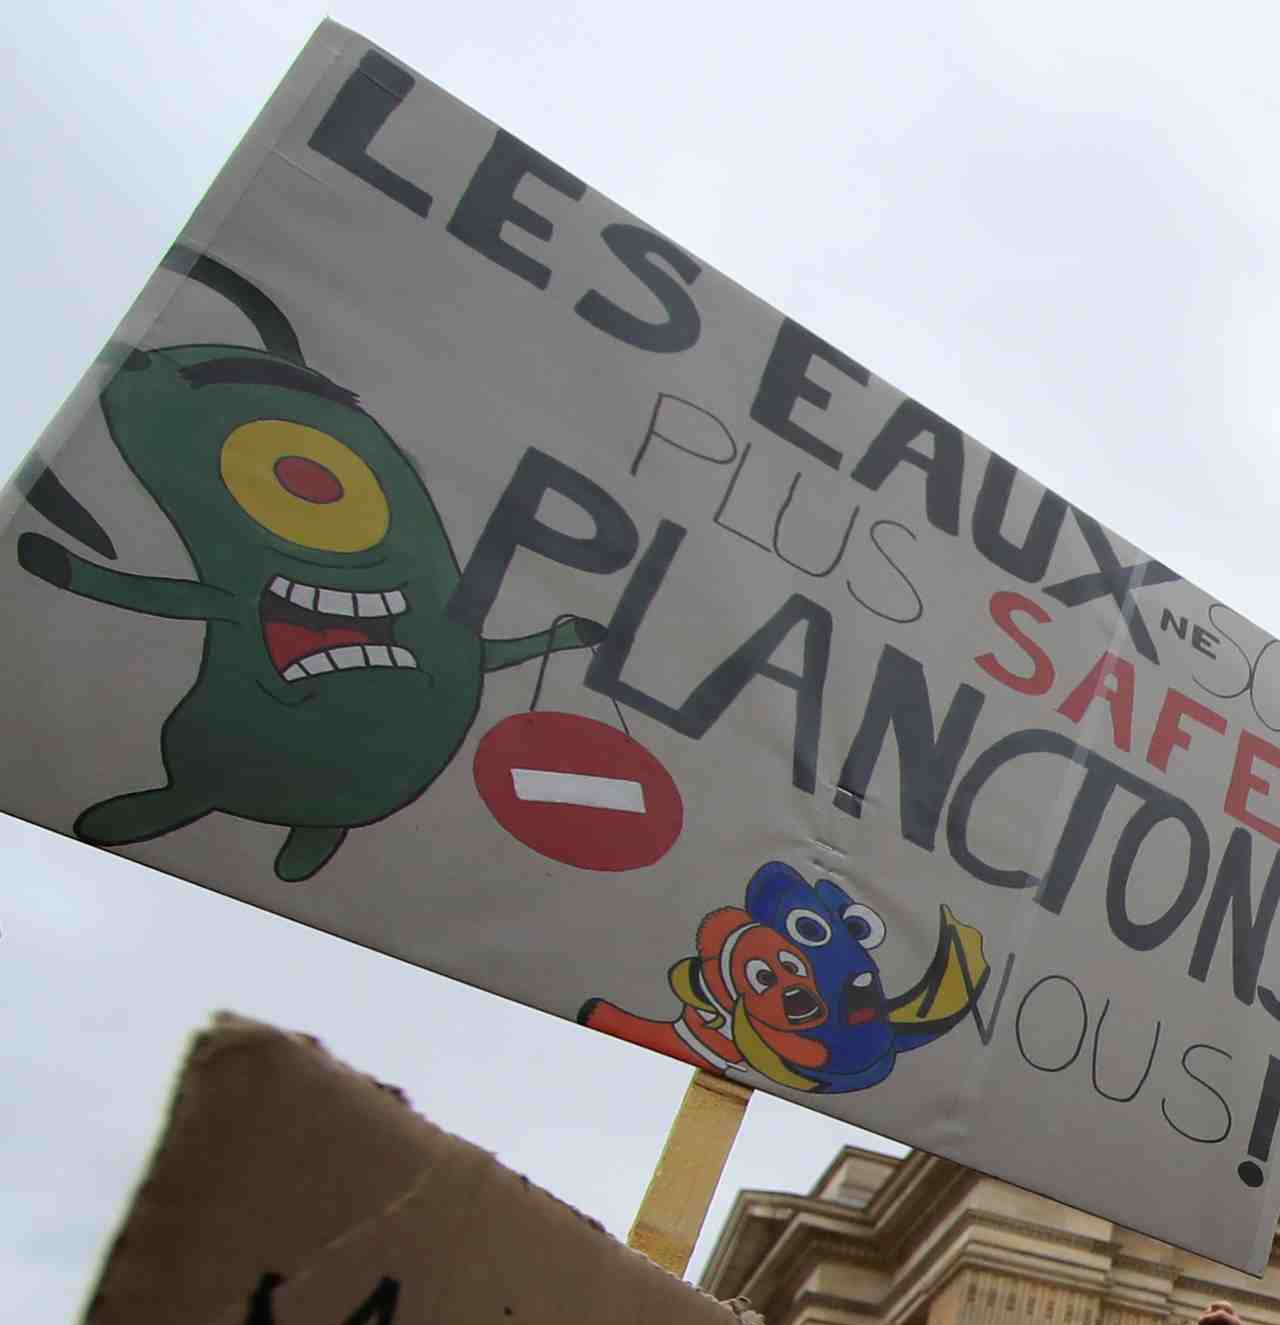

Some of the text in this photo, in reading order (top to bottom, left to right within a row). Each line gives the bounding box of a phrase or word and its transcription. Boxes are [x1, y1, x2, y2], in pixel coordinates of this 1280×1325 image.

[307, 48, 703, 354] LES
[750, 316, 1184, 665] EAUX
[1159, 606, 1222, 661] NE
[631, 392, 924, 624] PLUS
